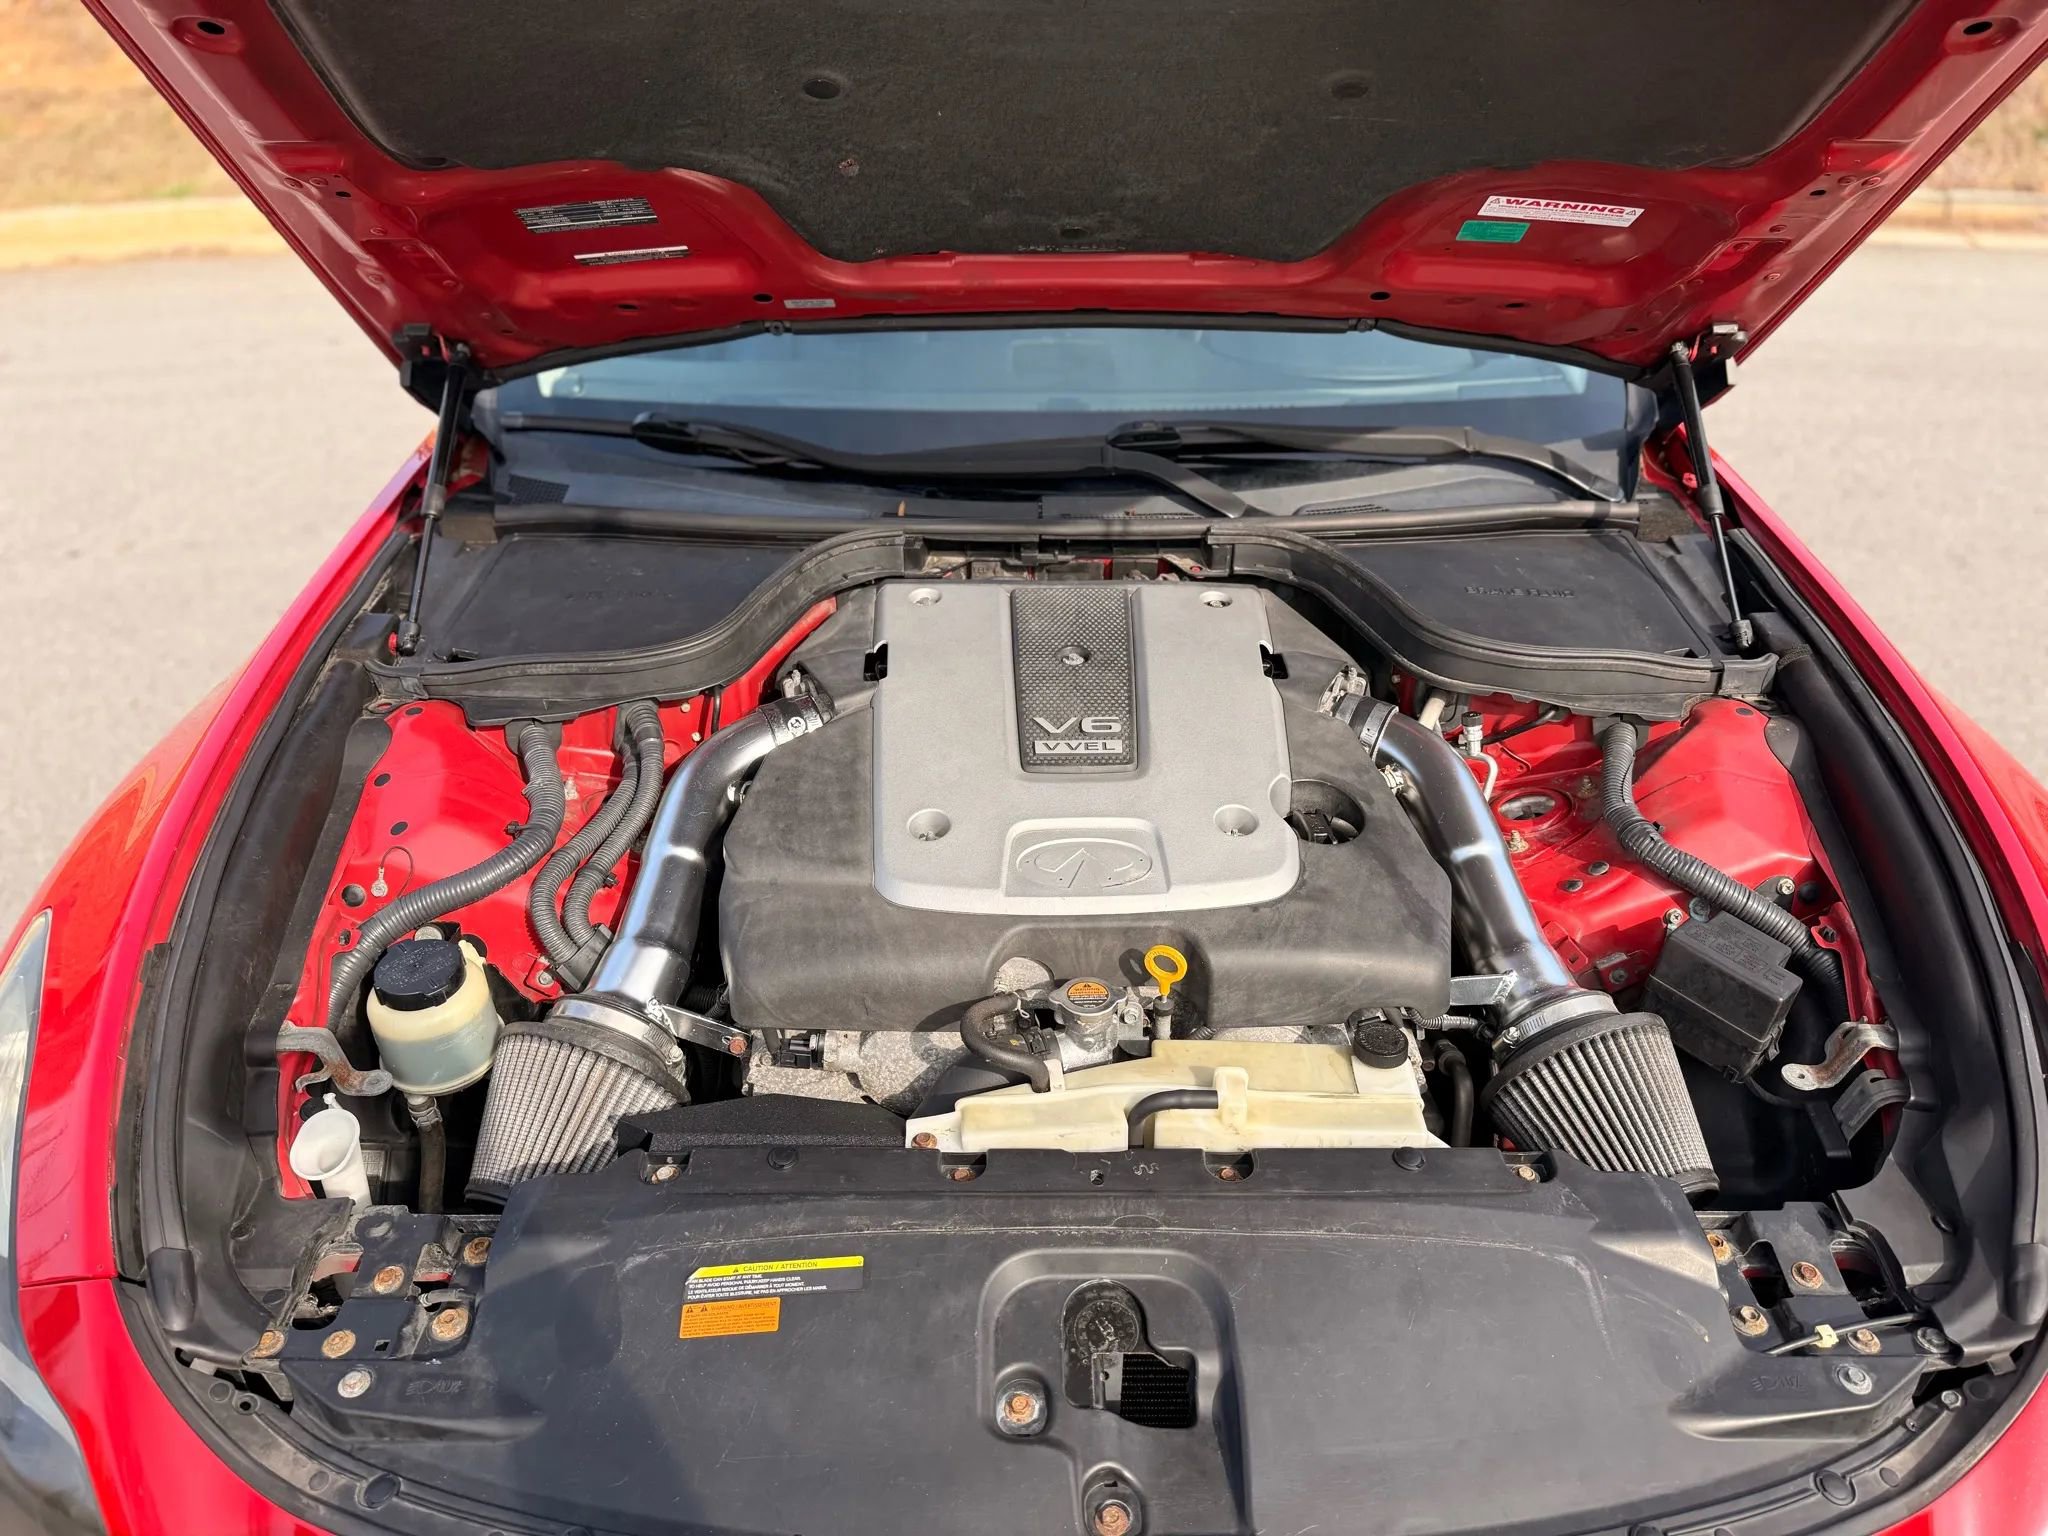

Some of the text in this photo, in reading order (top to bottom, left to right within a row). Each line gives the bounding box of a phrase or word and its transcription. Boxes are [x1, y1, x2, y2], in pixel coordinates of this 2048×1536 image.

[1504, 198, 1626, 214] WARNING
[1032, 716, 1122, 734] V6
[1042, 742, 1116, 751] VVEL
[780, 1261, 818, 1270] ATTENTION
